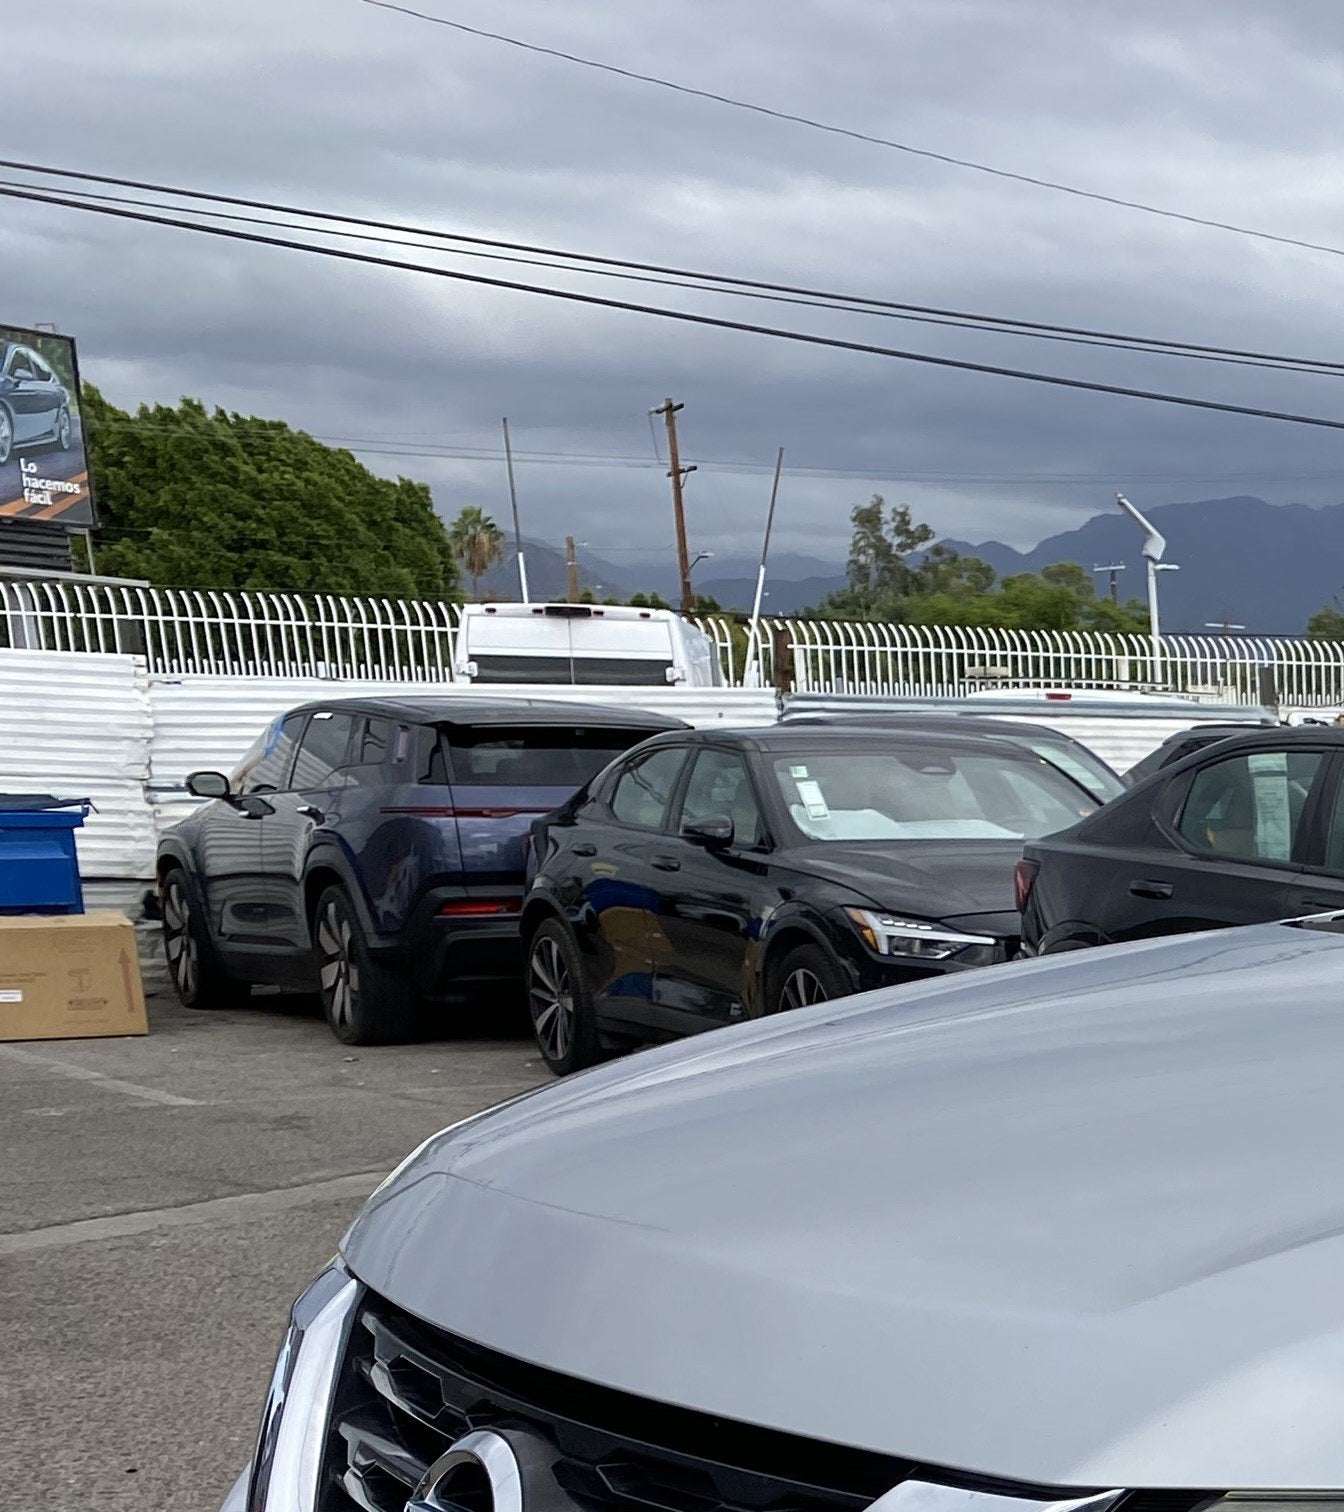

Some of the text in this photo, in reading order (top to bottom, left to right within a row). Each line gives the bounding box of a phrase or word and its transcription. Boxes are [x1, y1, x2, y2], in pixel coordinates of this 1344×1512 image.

[20, 458, 37, 473] Lo
[22, 472, 80, 494] hacemos
[23, 488, 53, 505] fácil
